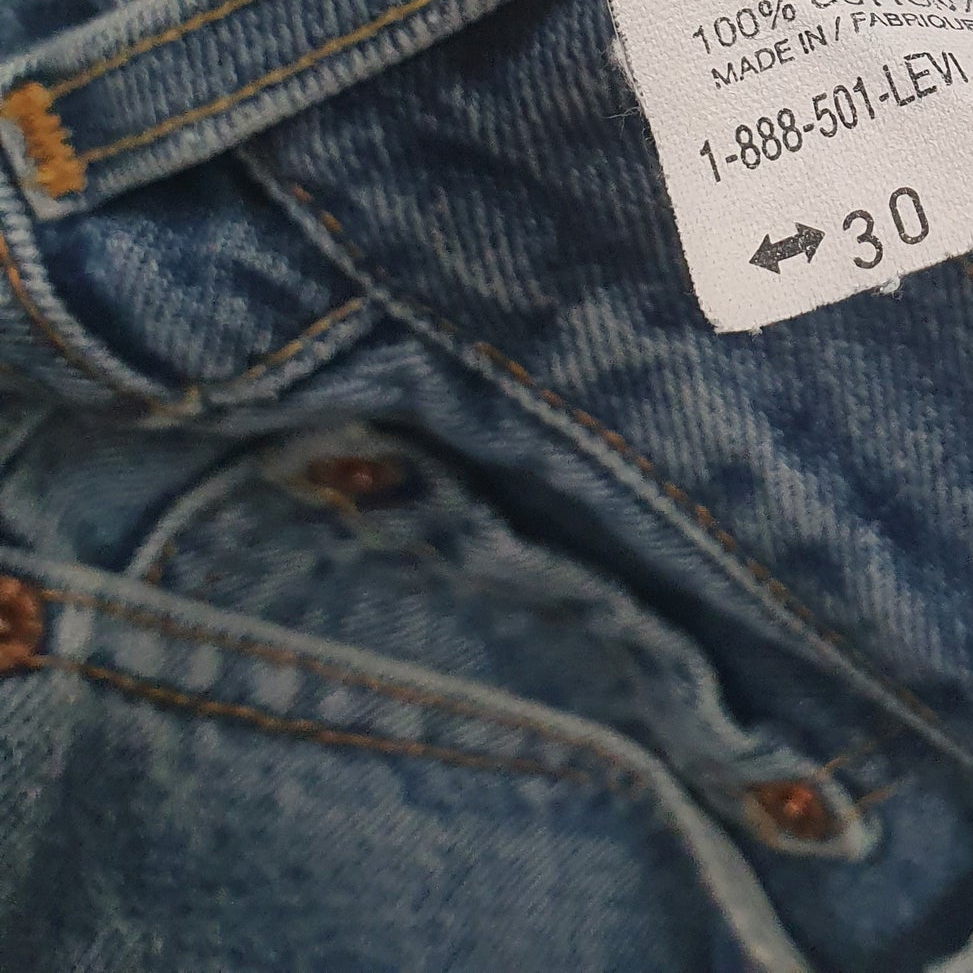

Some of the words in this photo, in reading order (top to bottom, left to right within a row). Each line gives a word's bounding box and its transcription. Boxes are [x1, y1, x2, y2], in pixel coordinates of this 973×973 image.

[710, 38, 795, 90] MADE
[798, 25, 828, 55] IN
[699, 50, 969, 183] 1-888-501-LEVI
[842, 186, 930, 270] 30
